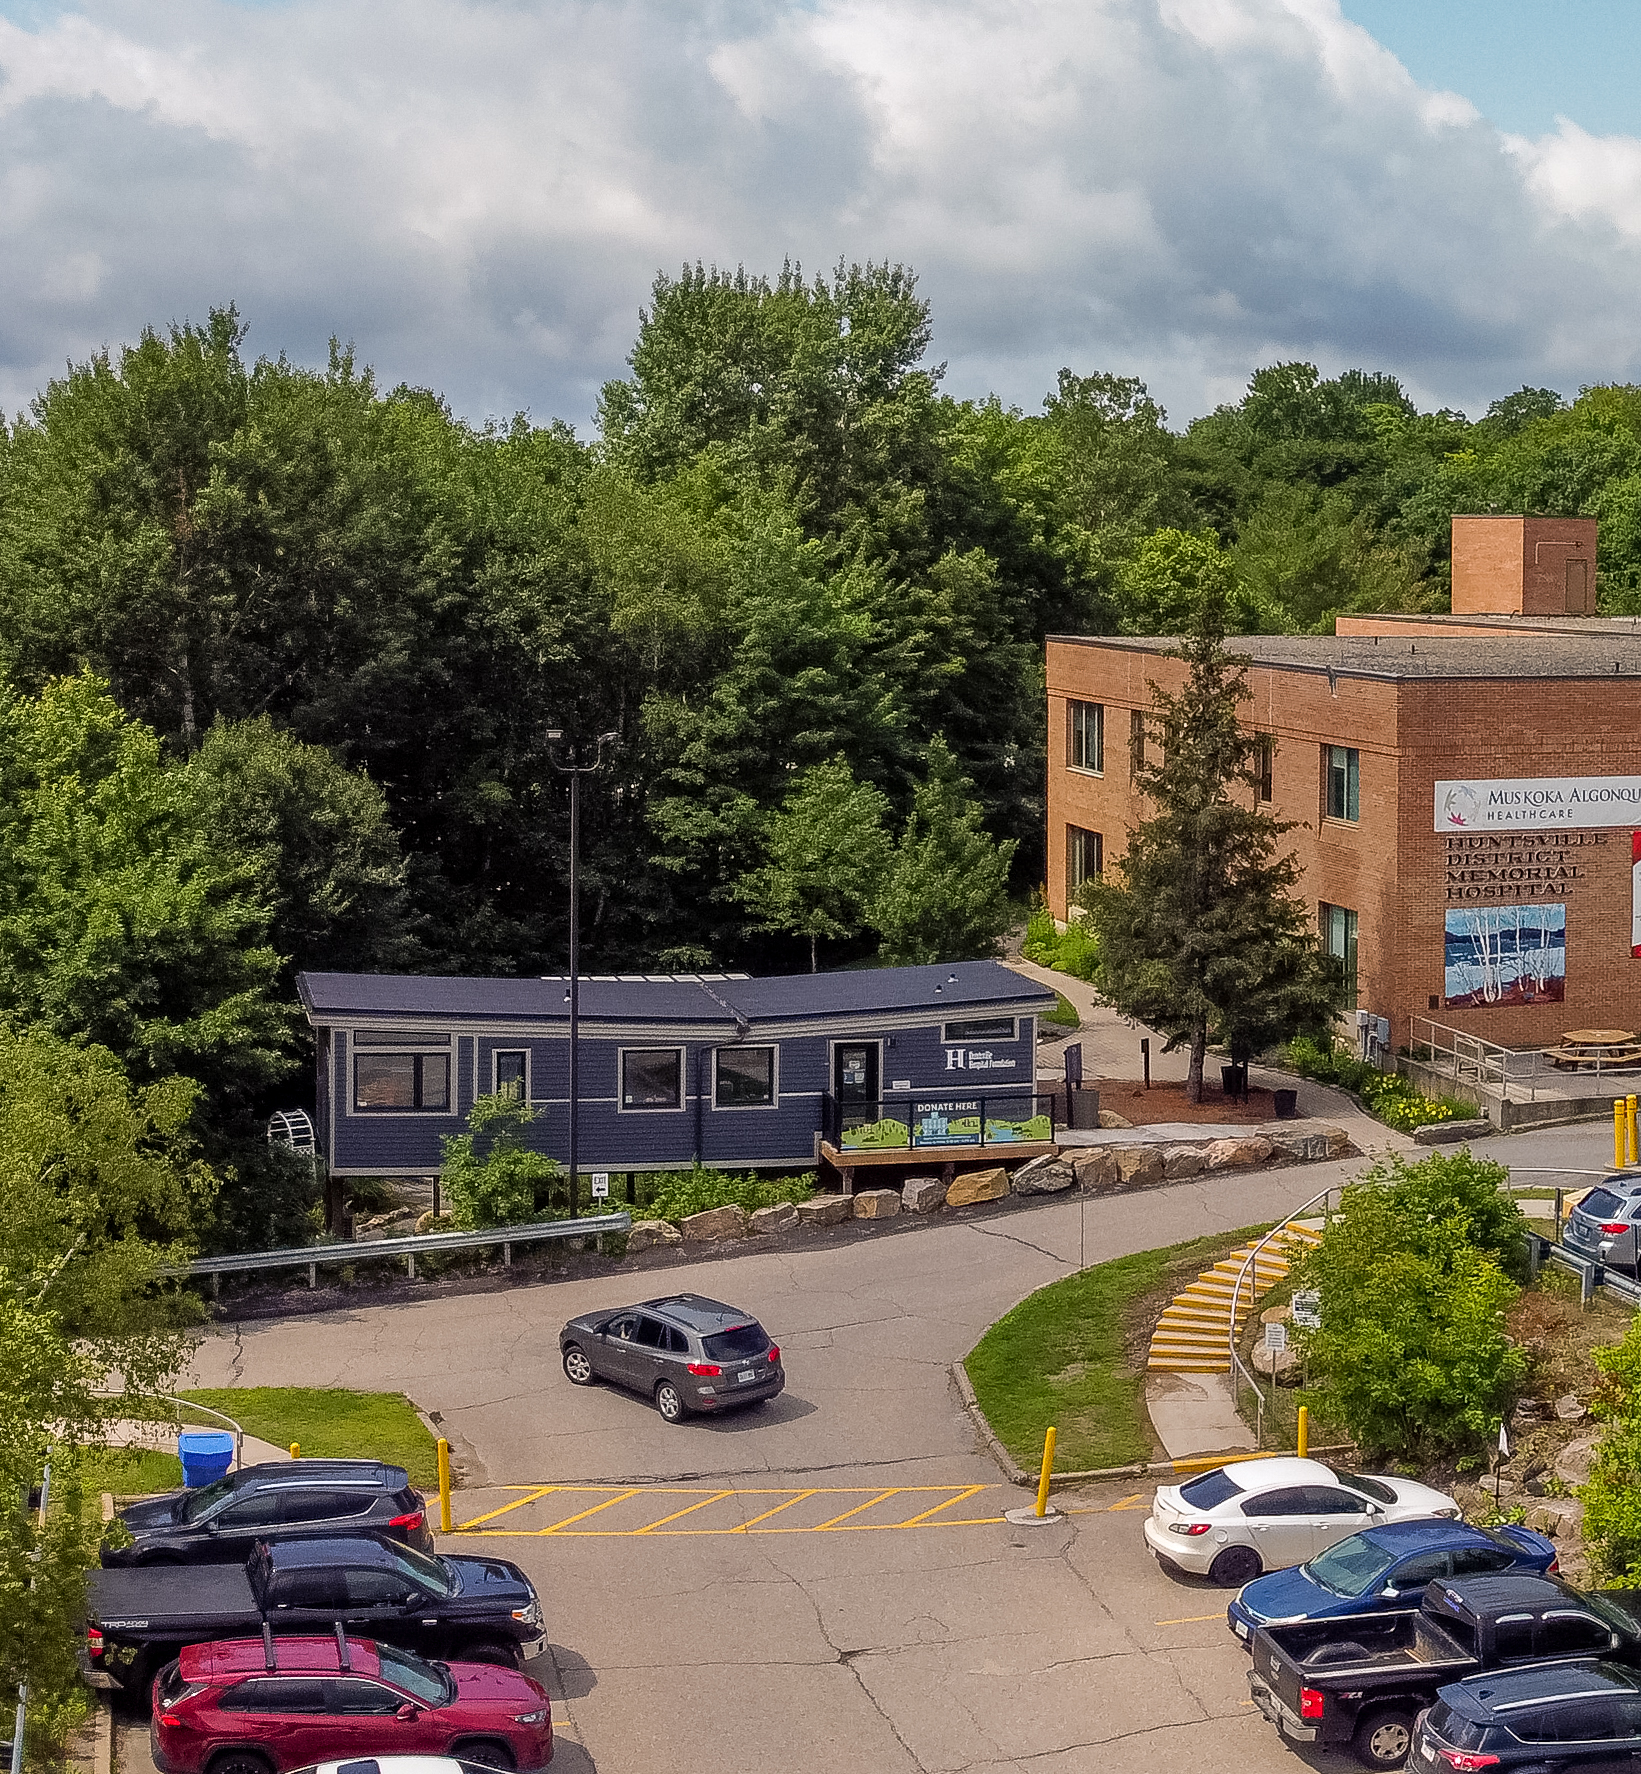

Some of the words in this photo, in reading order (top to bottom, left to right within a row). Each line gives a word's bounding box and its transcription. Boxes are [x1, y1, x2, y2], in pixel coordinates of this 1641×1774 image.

[1488, 790, 1563, 807] MUSKOKA
[1487, 809, 1573, 821] HEALTHCARE
[1446, 833, 1609, 849] HUNTSVILLE
[1446, 850, 1570, 866] DISTRICT
[1446, 866, 1585, 883] MEMORIAL
[1446, 883, 1574, 899] HOSPITAL
[944, 1049, 966, 1070] H
[917, 1103, 954, 1112] DONATE
[955, 1102, 978, 1110] HERE
